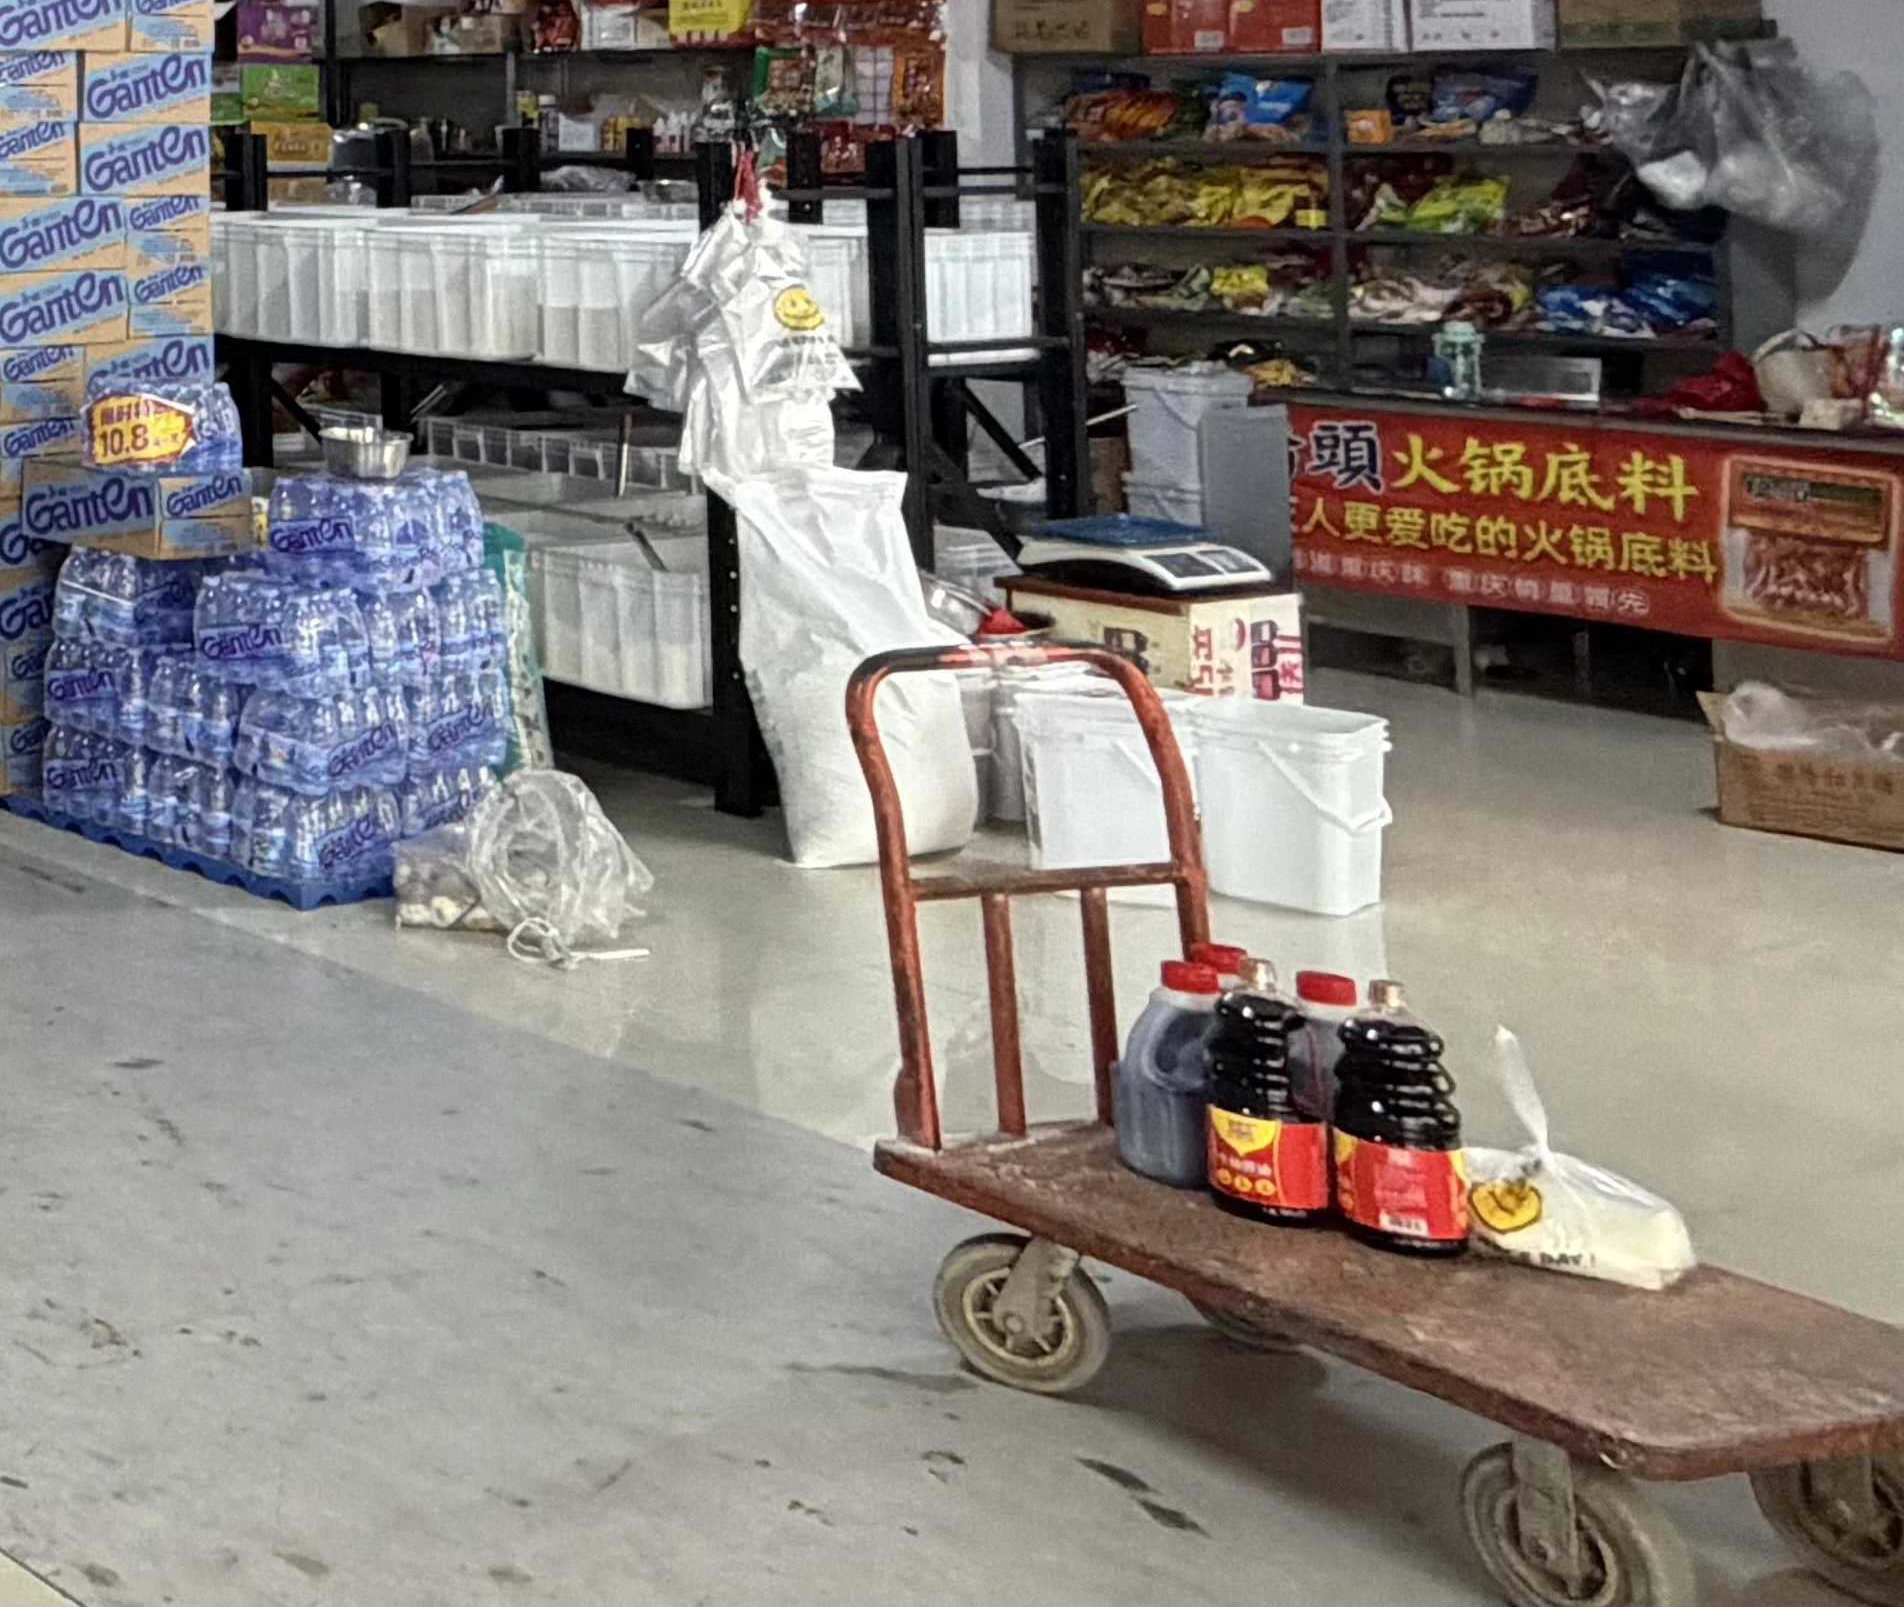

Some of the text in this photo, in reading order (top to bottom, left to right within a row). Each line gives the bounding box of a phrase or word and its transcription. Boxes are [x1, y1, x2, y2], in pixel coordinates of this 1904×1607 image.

[87, 55, 207, 119] Ganten
[85, 125, 206, 192] Ganten
[101, 423, 149, 457] 10.8
[26, 477, 151, 534] Ganten
